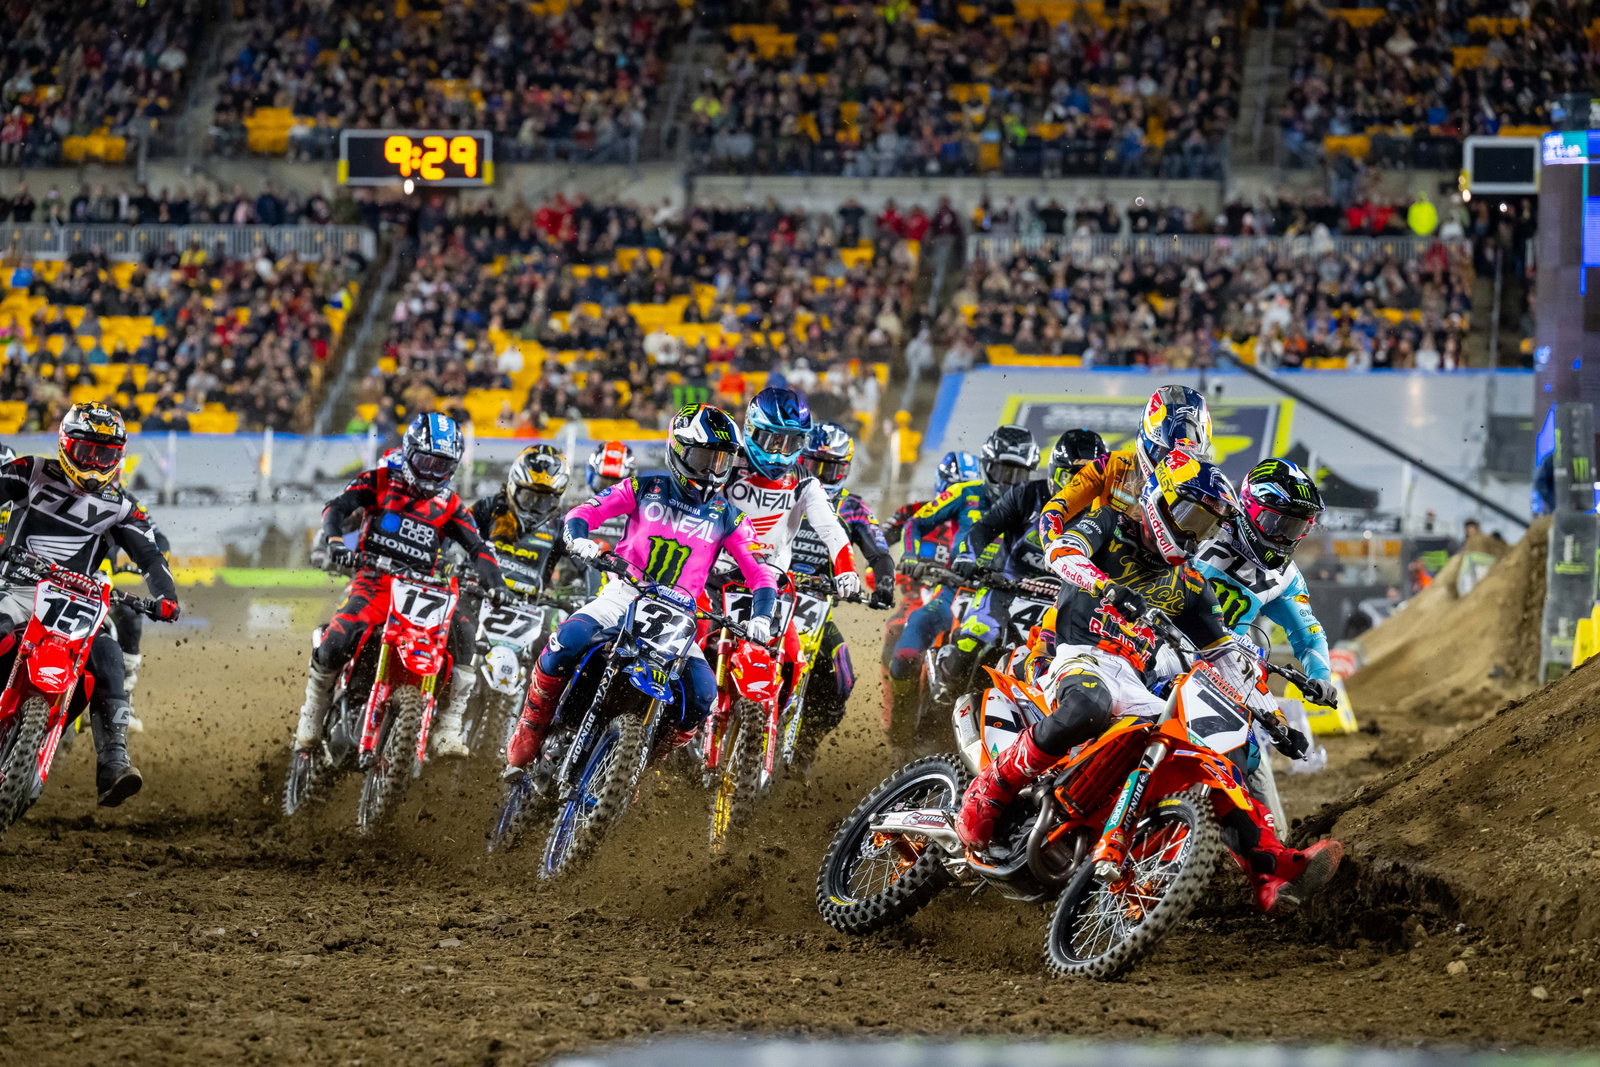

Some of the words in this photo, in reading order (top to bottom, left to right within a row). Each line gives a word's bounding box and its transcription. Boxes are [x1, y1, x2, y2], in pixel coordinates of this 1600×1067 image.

[384, 135, 478, 181] 9:29
[31, 484, 117, 529] FLY
[675, 501, 701, 516] YAMAHA
[399, 527, 433, 547] LOCK
[402, 518, 435, 538] QUAD
[1147, 504, 1162, 530] Red
[1155, 526, 1174, 553] Bull
[373, 533, 432, 562] HONDA
[792, 541, 829, 556] UZUK
[1061, 564, 1077, 580] Red
[1076, 575, 1093, 592] Bull
[1200, 540, 1279, 594] FLY
[41, 598, 97, 634] 15
[401, 589, 447, 620] 17
[482, 605, 541, 639] 27
[633, 603, 696, 650] 32
[1202, 667, 1240, 700] RENTHAL
[572, 712, 597, 764] DUNLOP
[1109, 788, 1130, 826] MOTOREX
[1123, 782, 1144, 831] DUNLOP
